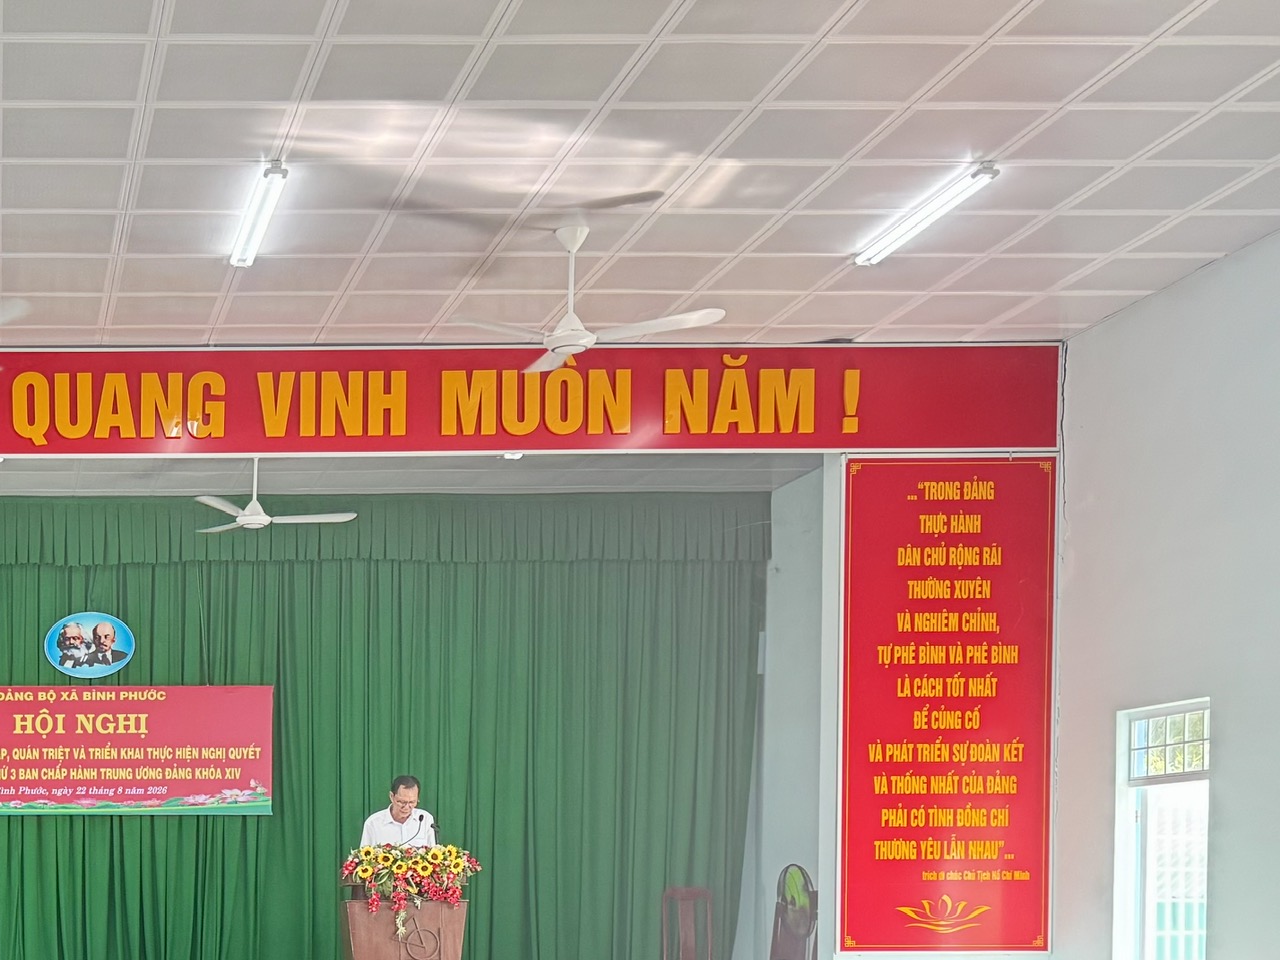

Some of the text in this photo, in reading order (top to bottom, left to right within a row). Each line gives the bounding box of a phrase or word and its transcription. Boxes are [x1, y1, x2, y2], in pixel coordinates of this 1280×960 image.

[12, 371, 225, 446] QUANG
[257, 371, 406, 437] VINH
[442, 354, 631, 435] MUÔN
[664, 354, 814, 434] NĂM
[842, 369, 860, 434] !
[964, 475, 994, 500] ĐẢNG
[919, 510, 981, 537] THỰC HÀNH
[898, 542, 1001, 569] DÂN CHỦ RỘNG RÃI
[908, 576, 991, 599] THƯỜNG XUYÊN
[897, 607, 1000, 634] VÀ NGHIÊM CHỈNH,
[877, 642, 1018, 668] TỰ PHÊ BÌNH VÀ PHÊ BÌNH
[38, 690, 56, 703] BỘ
[61, 689, 78, 700] XÃ
[83, 689, 115, 700] BÌNH
[120, 690, 166, 700] PHƯỚC
[897, 672, 997, 697] LÀ CÁCH TỐT NHẤT
[13, 708, 148, 739] HỘI NGHỊ
[913, 704, 981, 730] ĐỂ CỦNG CỐ
[12, 745, 39, 760] QUÁN
[42, 747, 70, 763] TRIỆT
[73, 745, 86, 759] VÀ
[89, 742, 118, 759] TRIỂN
[121, 748, 143, 759] KHAI
[147, 747, 172, 762] THỰC
[176, 746, 198, 762] HIỆN
[202, 748, 225, 762] NGHỊ
[229, 743, 261, 760] QUYẾT
[869, 736, 1024, 766] VÀ PHÁT TRIỂN SỰ ĐOÀN KẾT
[11, 769, 16, 780] 3
[20, 769, 38, 780] BAN
[41, 764, 67, 780] CHẤP
[71, 765, 97, 779] HÀNH
[100, 768, 132, 779] TRUNG
[136, 767, 162, 779] ƯƠNG
[165, 764, 192, 780] ĐẢNG
[196, 765, 222, 779] KHÓA
[225, 768, 241, 779] XIV
[874, 770, 1017, 794] VÀ THỐNG NHẤT CỦA ĐẢNG
[19, 786, 49, 795] Phước,
[52, 787, 73, 796] ngày
[89, 786, 115, 796] tháng
[881, 802, 1009, 827] PHẢI CÓ TÌNH ĐỒNG CHÍ
[874, 838, 917, 860] THƯƠNG
[920, 837, 941, 860] YÊU
[944, 834, 965, 860] LẪN
